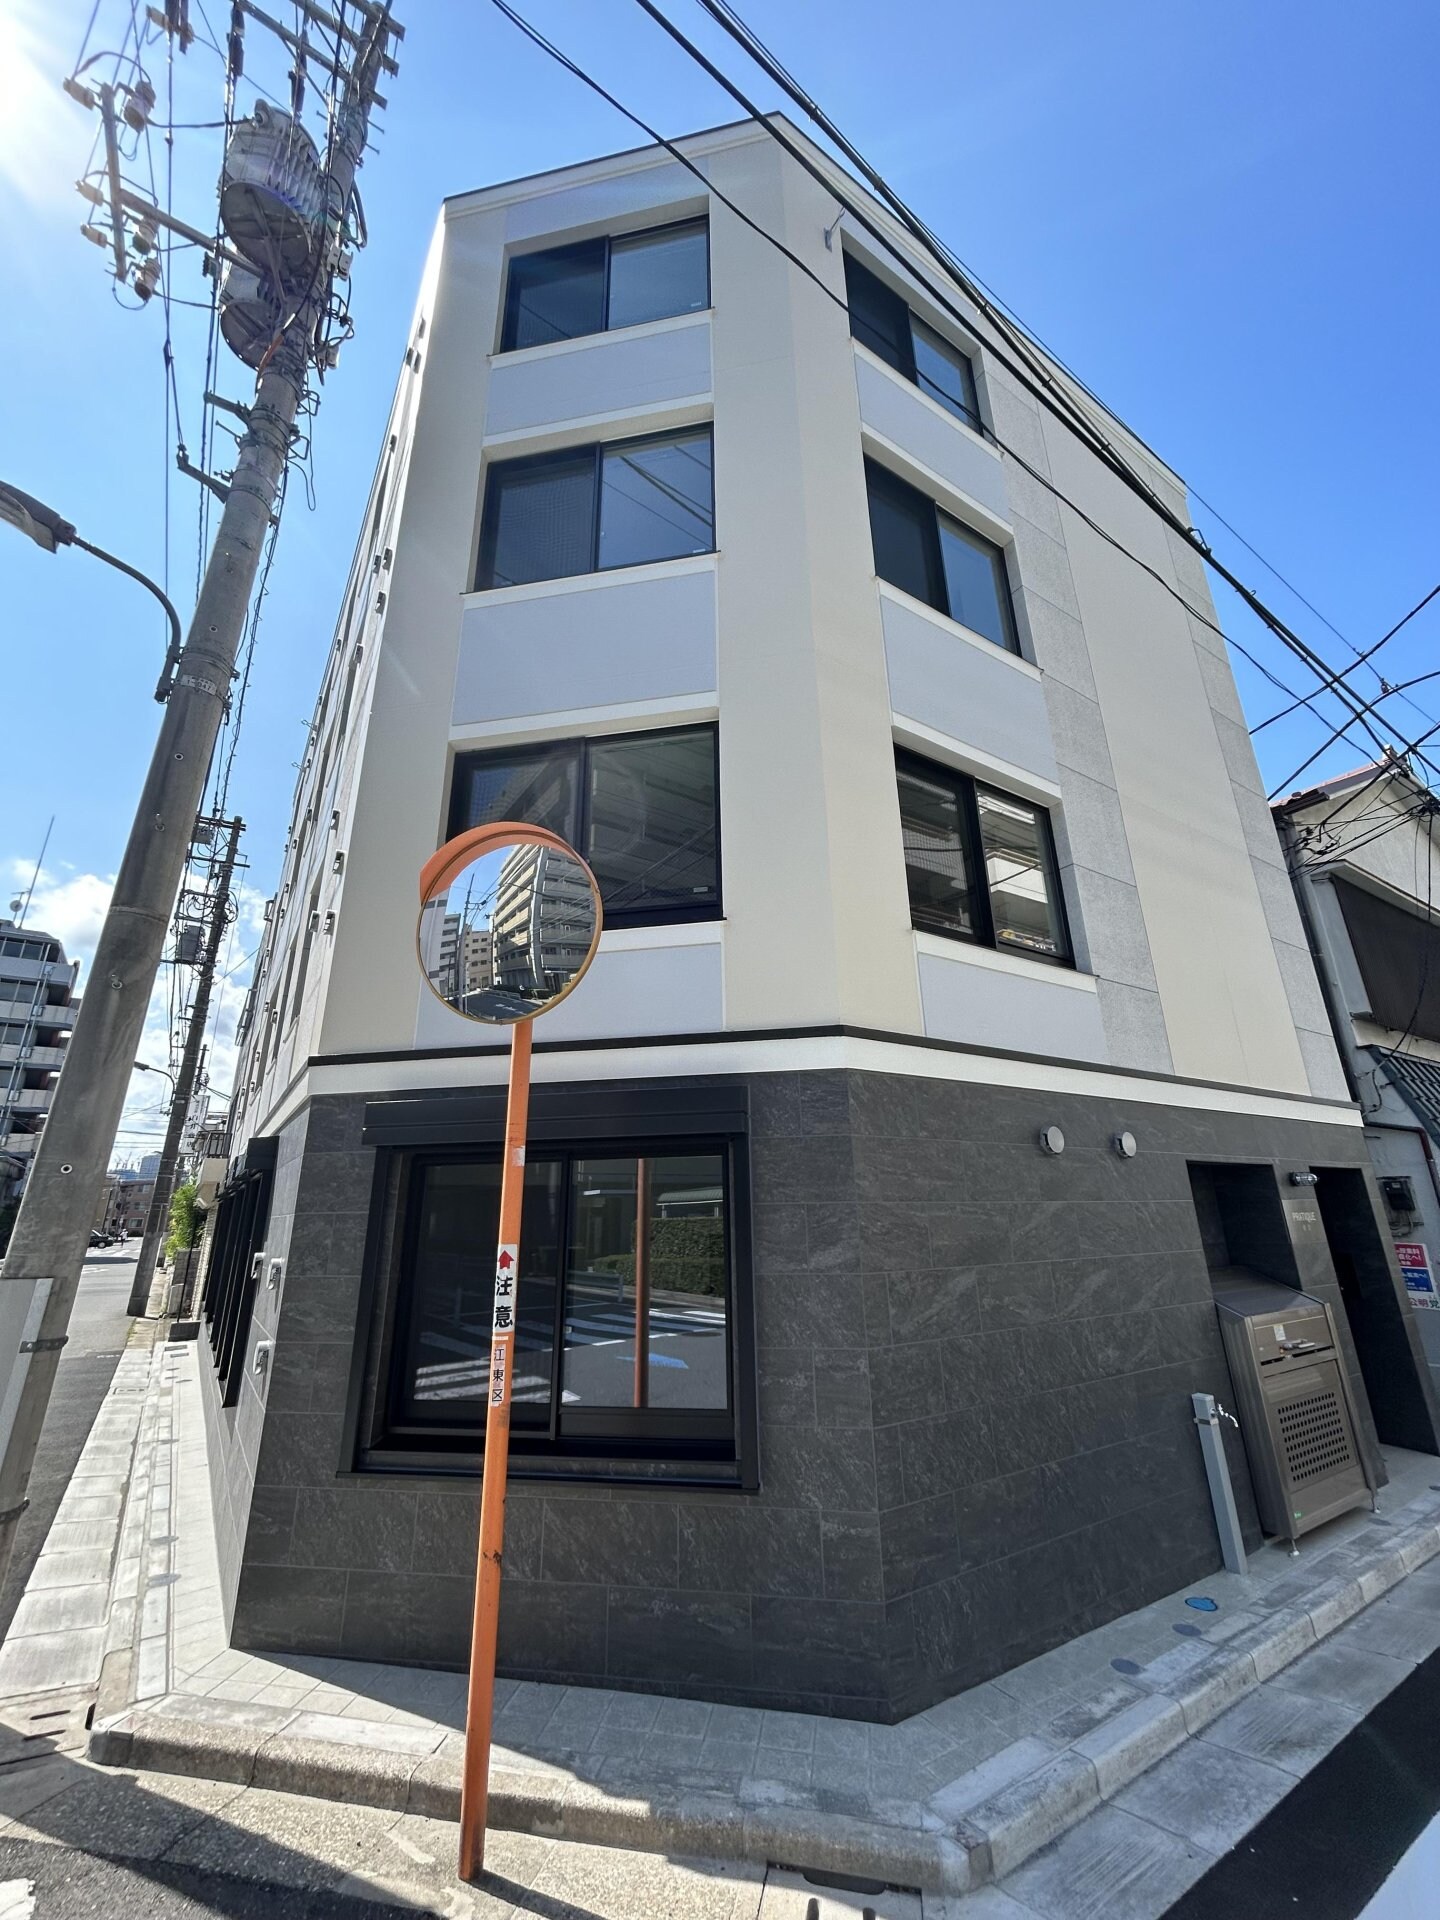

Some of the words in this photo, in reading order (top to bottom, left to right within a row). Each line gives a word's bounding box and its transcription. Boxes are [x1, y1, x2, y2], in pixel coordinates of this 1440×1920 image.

[495, 1275, 513, 1328] 注意
[492, 1348, 505, 1402] 江東区
